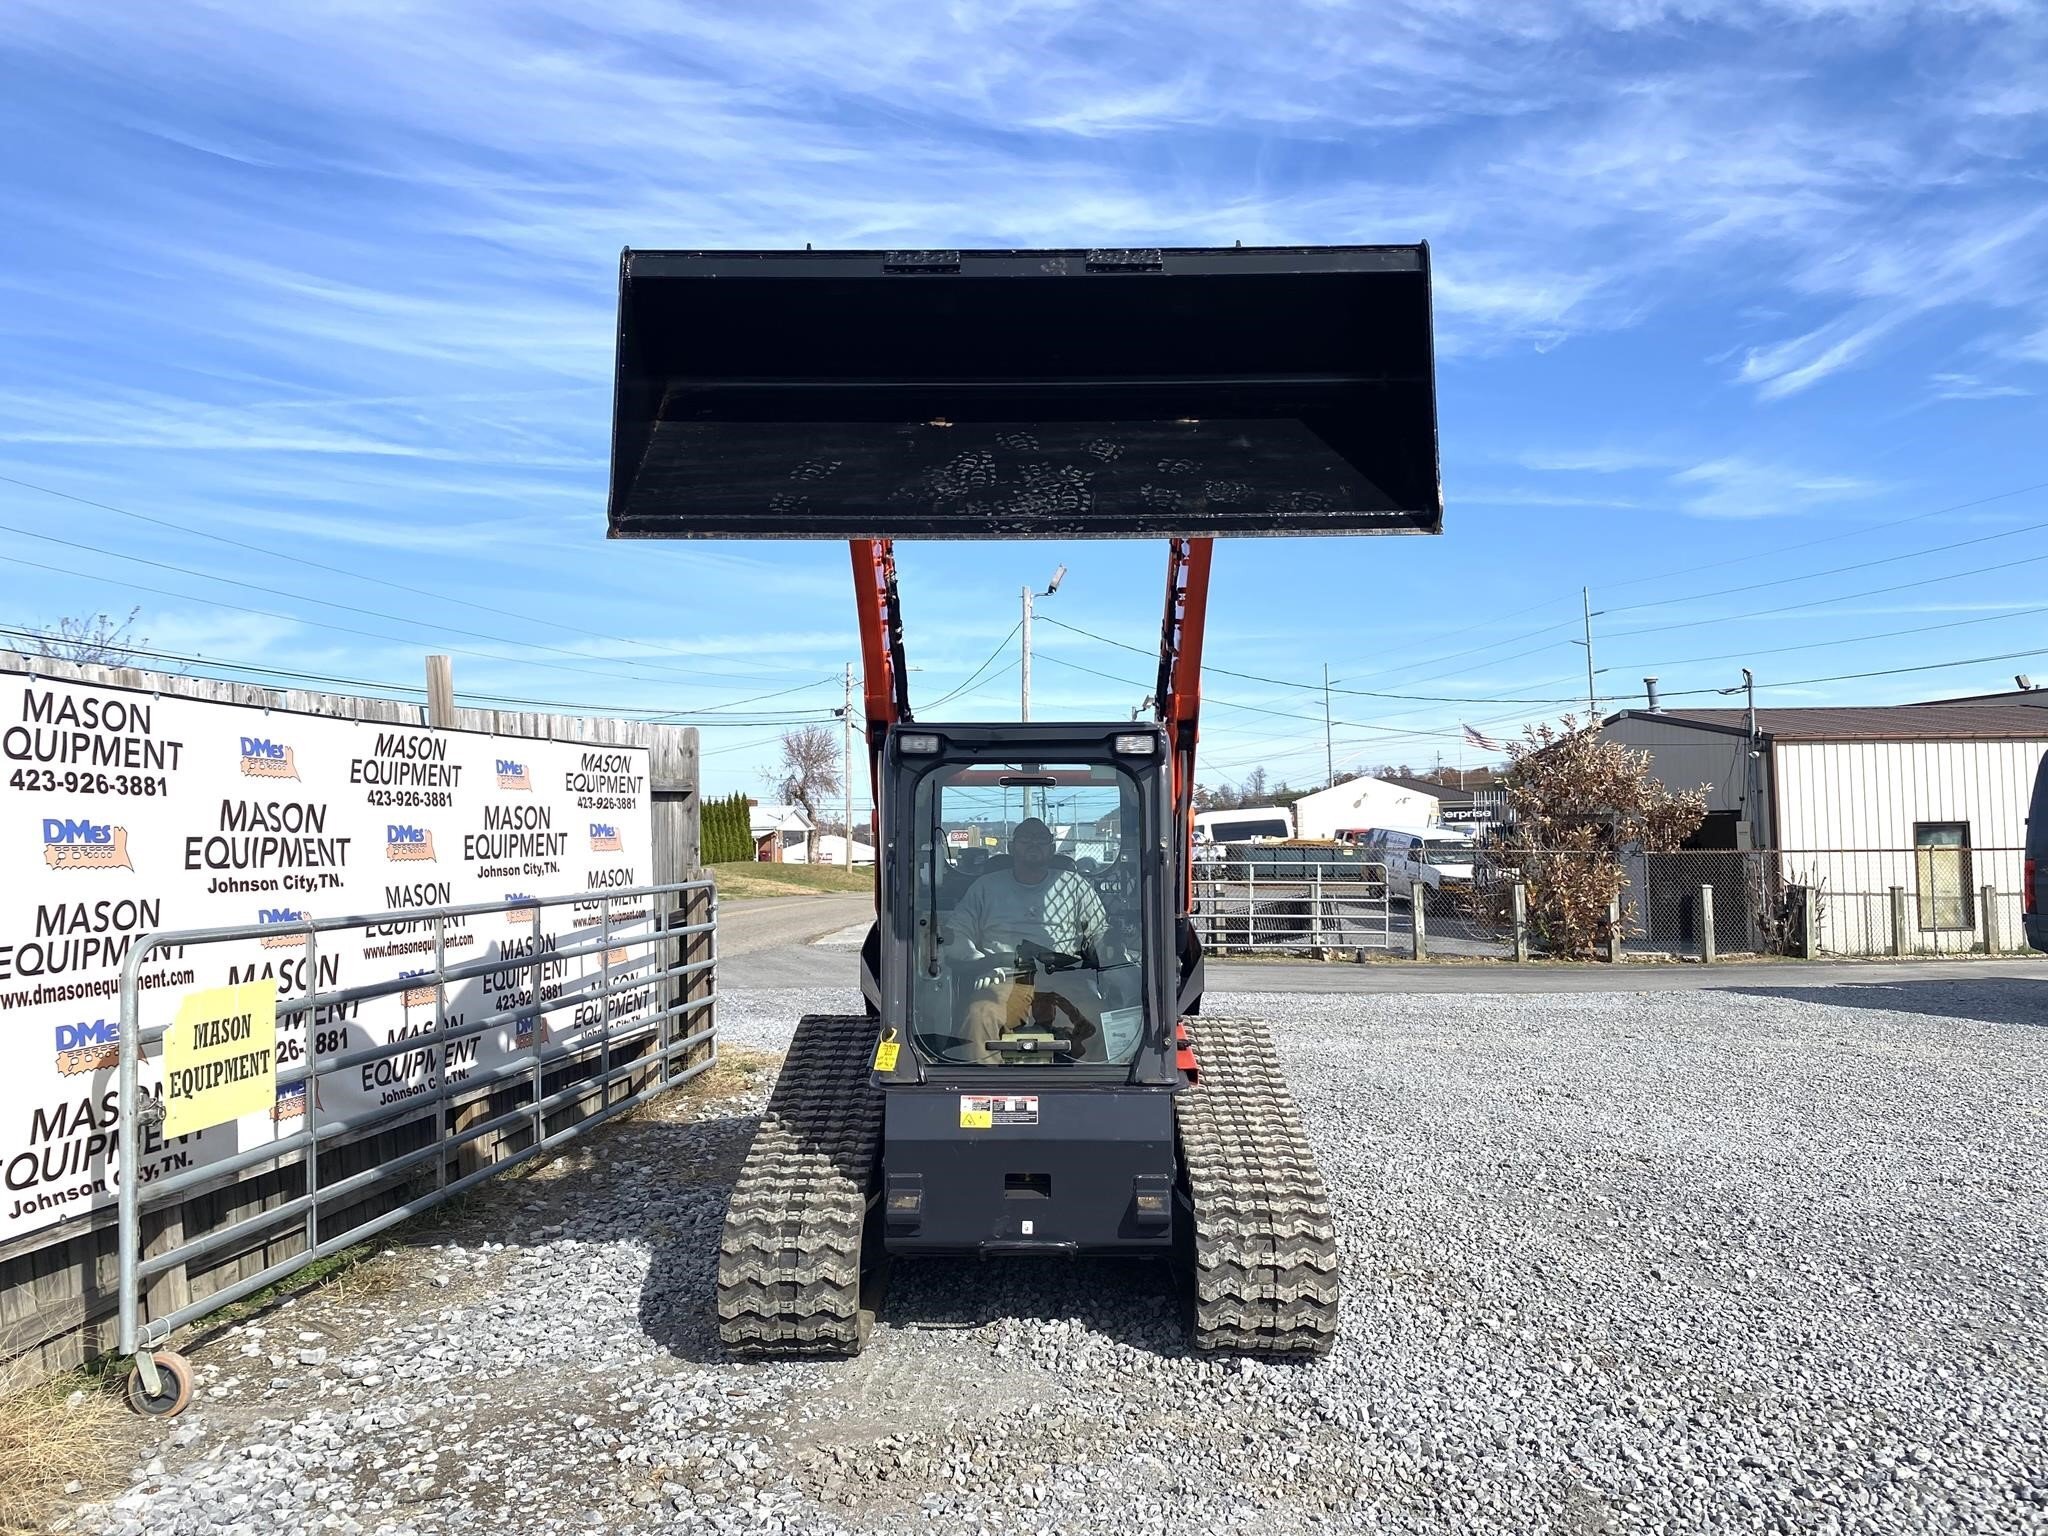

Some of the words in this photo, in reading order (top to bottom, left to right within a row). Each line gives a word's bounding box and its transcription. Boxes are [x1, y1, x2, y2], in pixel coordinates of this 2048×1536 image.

[22, 688, 151, 734] MASON
[2, 726, 183, 771] QUIPMENT
[374, 733, 447, 761] MASON
[350, 758, 462, 788] EQUIPMENT
[580, 752, 632, 773] MASON
[9, 768, 167, 797] 423-926-3881
[565, 772, 643, 795] EQUIPMENT
[367, 789, 453, 807] 423-926-3881
[577, 796, 636, 810] 423-926-3881
[220, 799, 327, 834] MASON
[484, 805, 551, 831] MASON
[185, 836, 351, 870] EQUIPMENT
[464, 832, 568, 861] EQUIPMENT
[207, 876, 279, 894] Johnson
[477, 863, 521, 879] Johnson
[588, 868, 634, 889] MASON
[386, 882, 451, 909] MASON
[35, 898, 161, 938] MASON
[573, 908, 647, 929] www.dmasequipment.com
[0, 933, 185, 980] EQUIPMN
[363, 933, 474, 960] www.dmasonequient.com
[0, 968, 195, 1010] ww.dmasonequient.com
[483, 958, 568, 995] EQUIPENT
[495, 982, 563, 1012] 423-923881
[573, 989, 650, 1029] EQUPMENT
[193, 1013, 252, 1051] MASON
[169, 1048, 271, 1100] EQUIPMENT
[361, 1036, 481, 1092] EQUIPMENT
[379, 1082, 427, 1106] Johnson
[30, 1081, 163, 1146] MAS
[0, 1127, 203, 1192] QUIPE
[8, 1177, 106, 1219] Johnson
[113, 1151, 193, 1186] Cy,TN.
